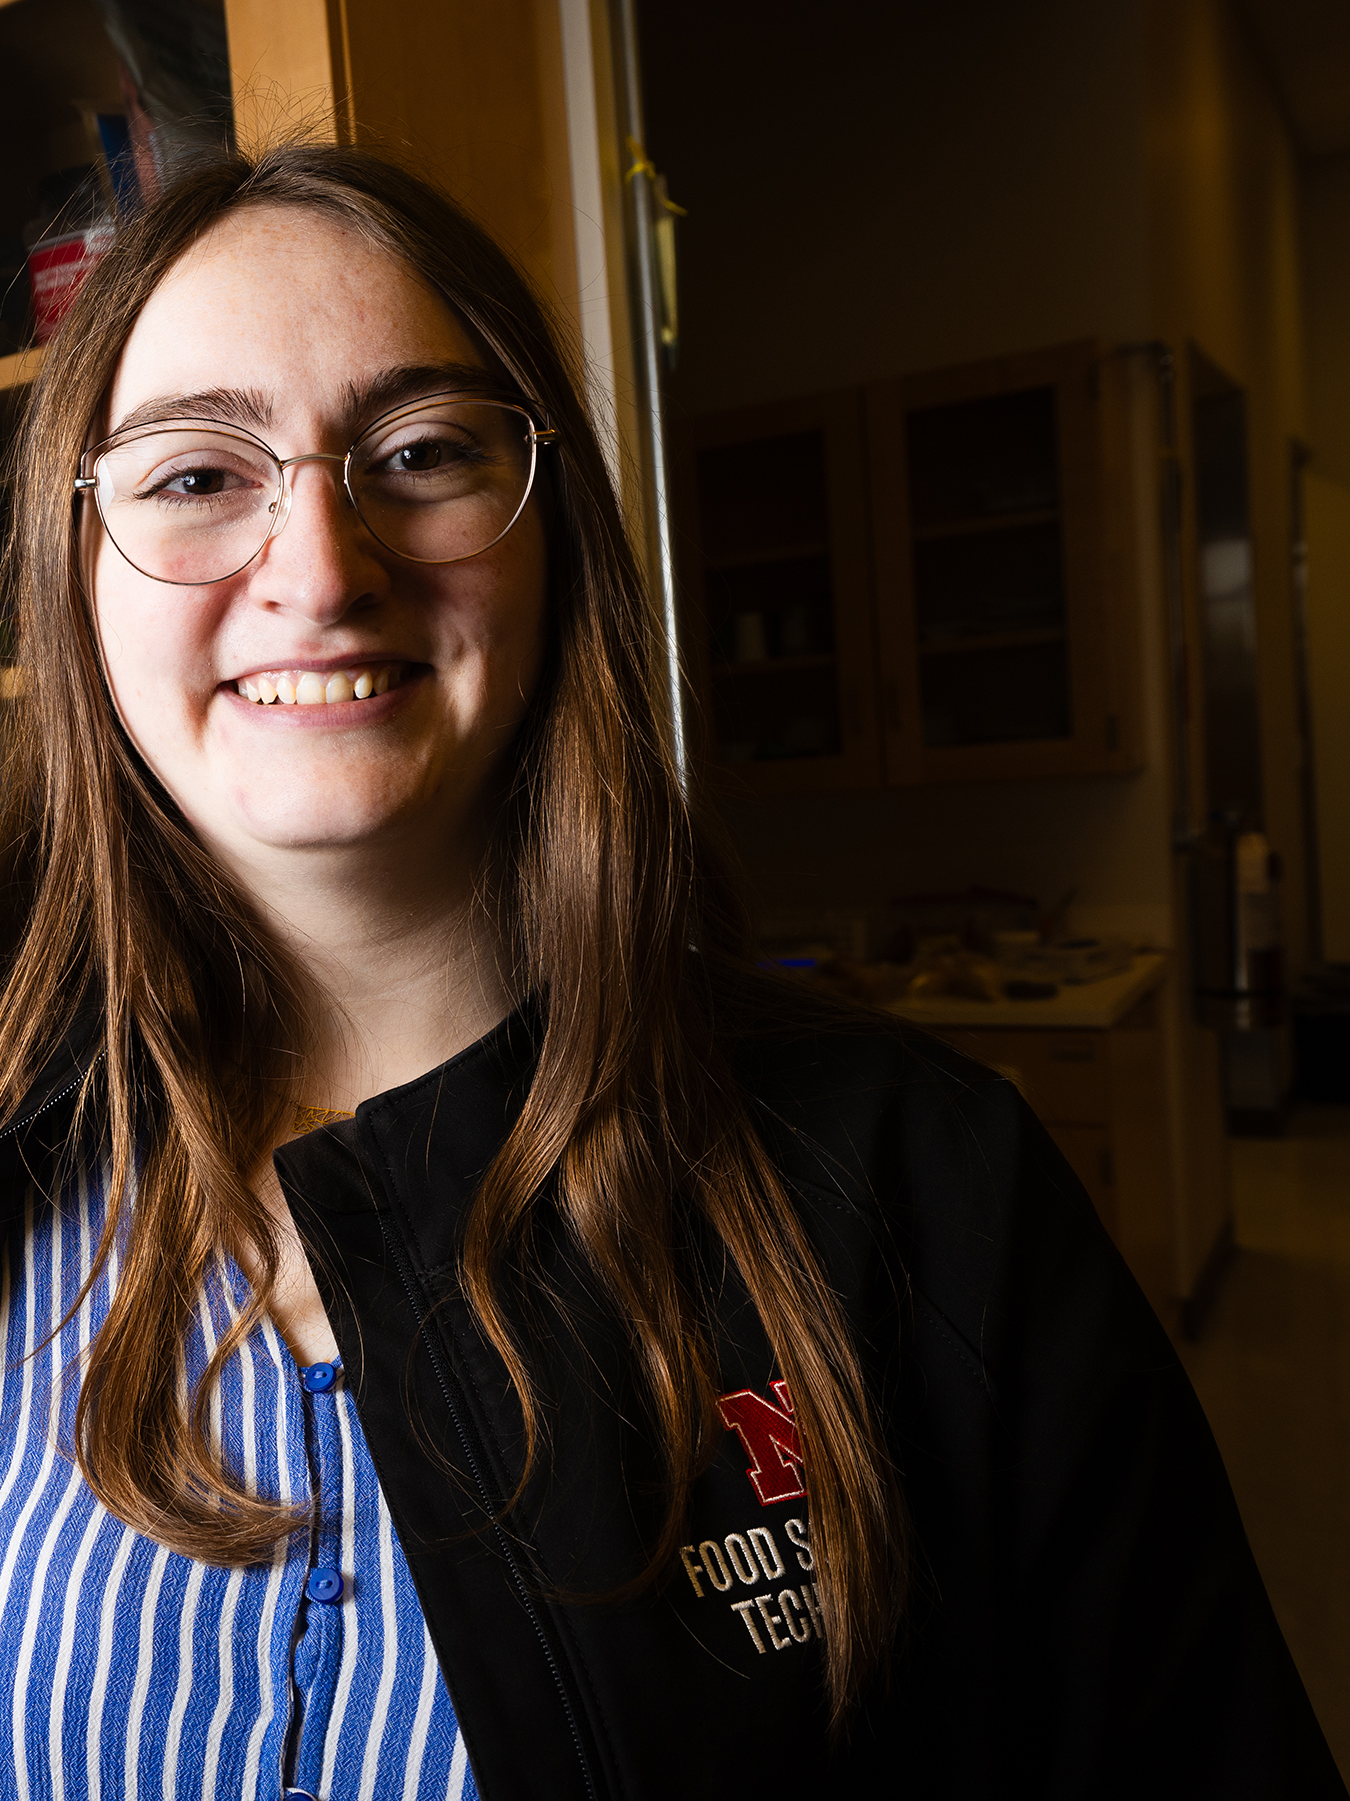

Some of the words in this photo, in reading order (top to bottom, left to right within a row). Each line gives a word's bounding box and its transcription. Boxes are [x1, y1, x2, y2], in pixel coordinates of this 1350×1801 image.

[715, 1379, 808, 1506] N
[679, 1526, 786, 1599] FOOD
[784, 1518, 815, 1571] S
[730, 1582, 826, 1655] TECH
